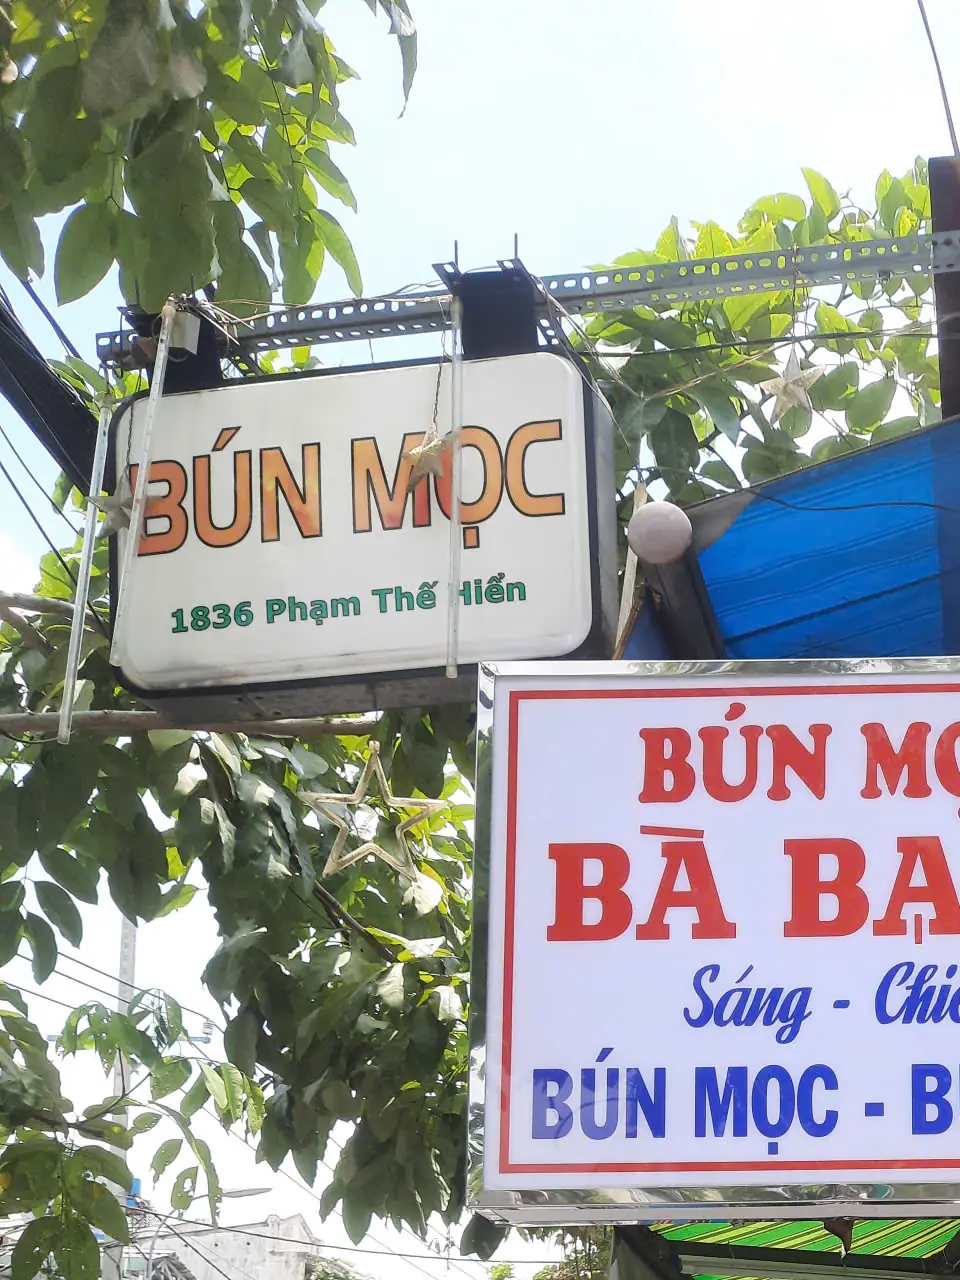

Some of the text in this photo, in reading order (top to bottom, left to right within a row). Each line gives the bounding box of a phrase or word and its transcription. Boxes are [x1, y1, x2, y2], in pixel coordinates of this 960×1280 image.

[128, 418, 567, 557] BÚN MỌC
[170, 601, 254, 634] 1836
[265, 594, 361, 627] Phạm
[371, 580, 439, 614] Thế
[638, 701, 833, 804] BÚN
[546, 824, 737, 943] BÀ
[682, 963, 814, 1044] Sáng
[530, 1047, 667, 1141] BÚN
[694, 1064, 839, 1157] MỌC
